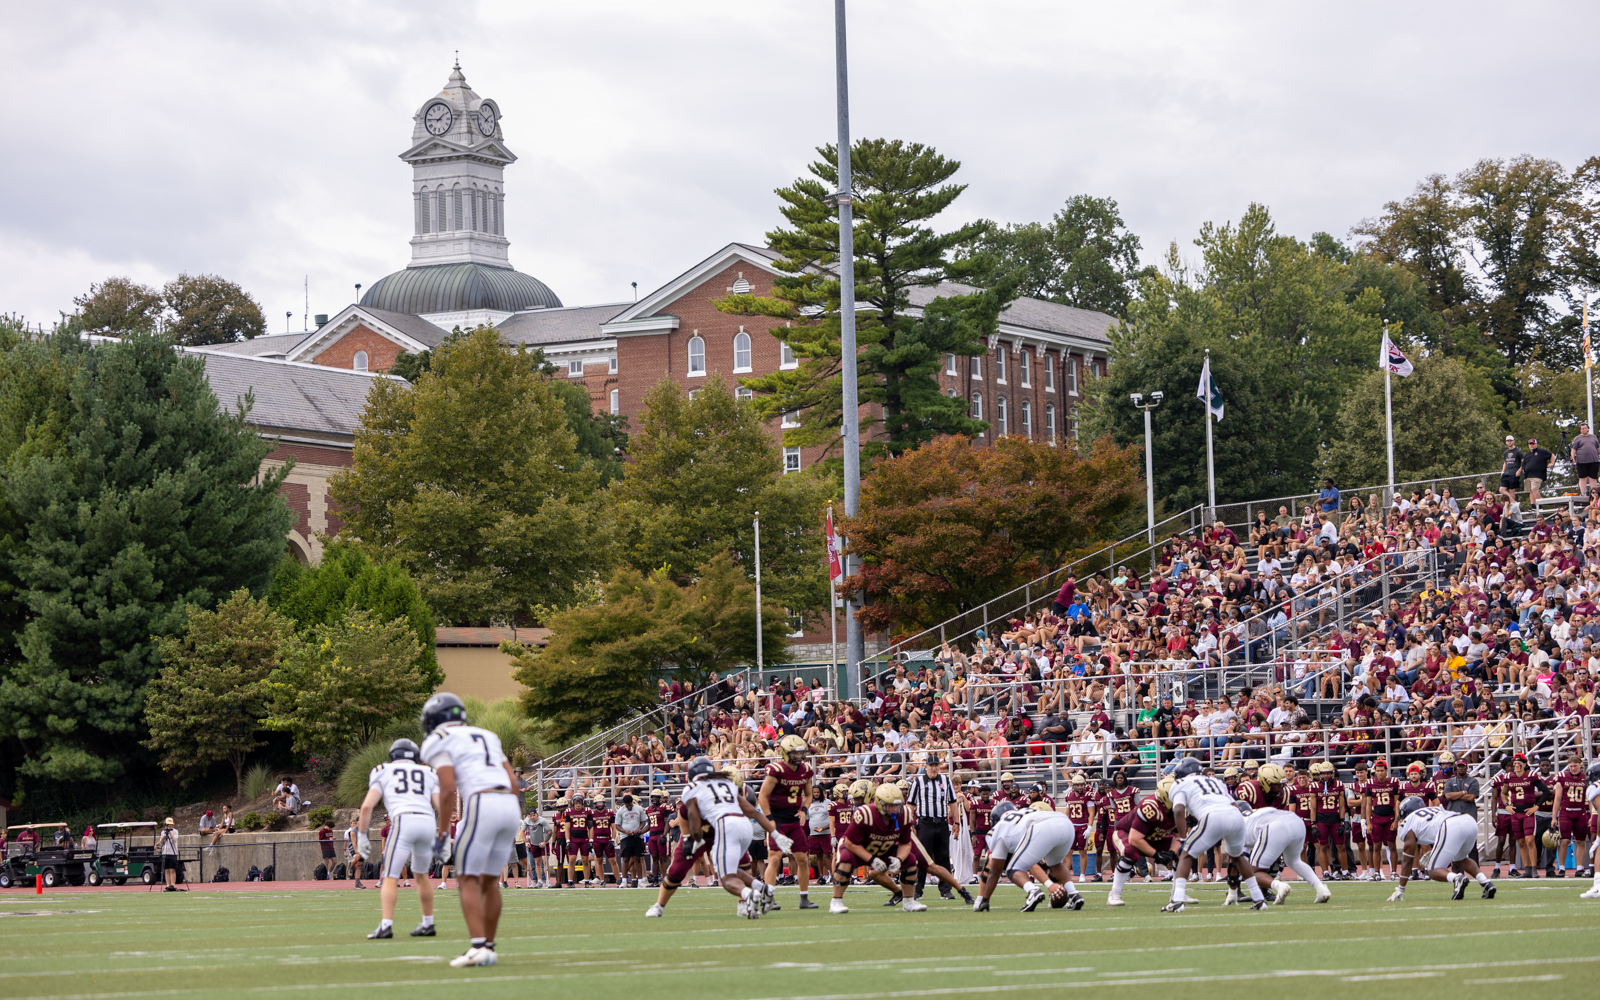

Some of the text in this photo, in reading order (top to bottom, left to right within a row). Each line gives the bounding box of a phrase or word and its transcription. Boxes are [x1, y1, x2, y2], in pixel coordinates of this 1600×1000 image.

[470, 733, 496, 767] 7
[392, 768, 425, 795] 39
[706, 781, 735, 805] 13
[787, 785, 800, 804] 3
[1515, 787, 1525, 800] 2
[1566, 786, 1584, 803] 40
[1069, 804, 1083, 818] 33
[1115, 798, 1131, 813] 59
[1142, 804, 1156, 820] 68
[572, 817, 586, 828] 36
[865, 840, 895, 857] 69
